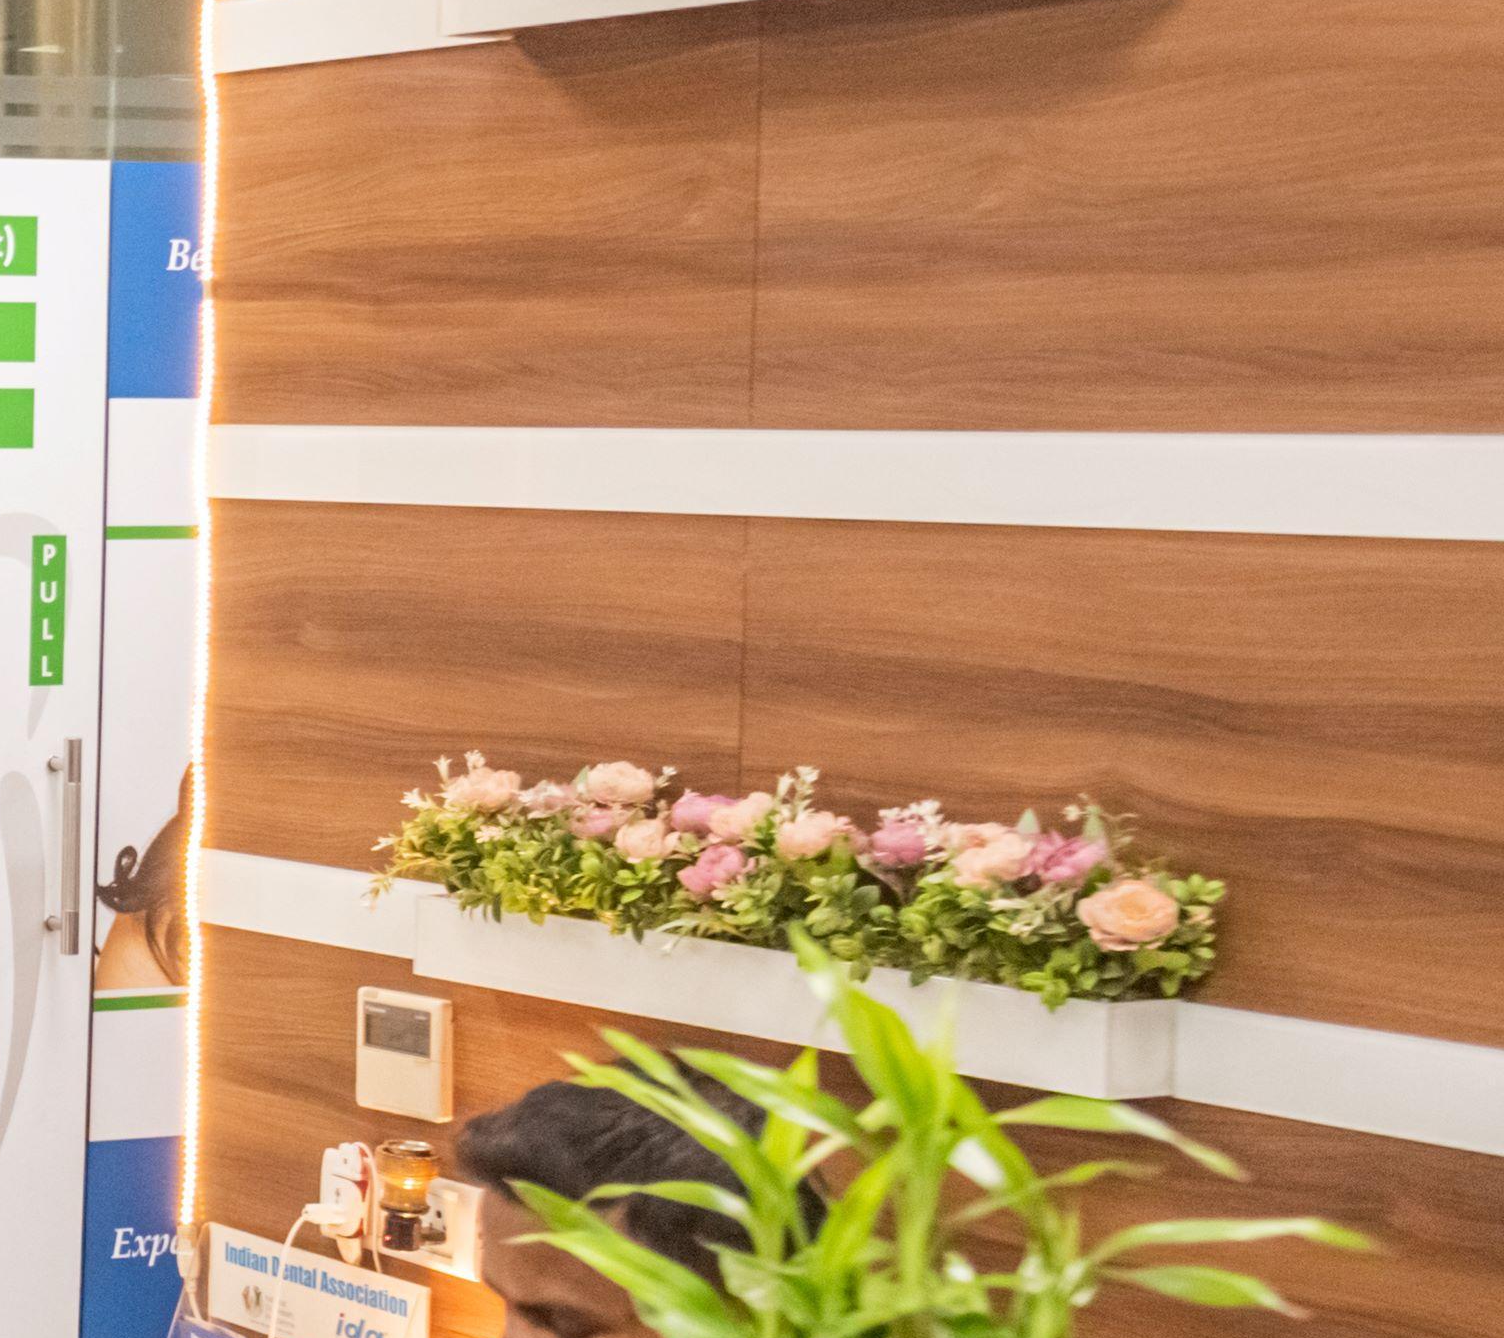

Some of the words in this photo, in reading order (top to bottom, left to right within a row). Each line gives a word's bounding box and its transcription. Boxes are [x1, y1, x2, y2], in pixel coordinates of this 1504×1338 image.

[39, 543, 57, 678] PULL
[224, 1241, 269, 1276] Indian
[320, 1270, 409, 1317] Association
